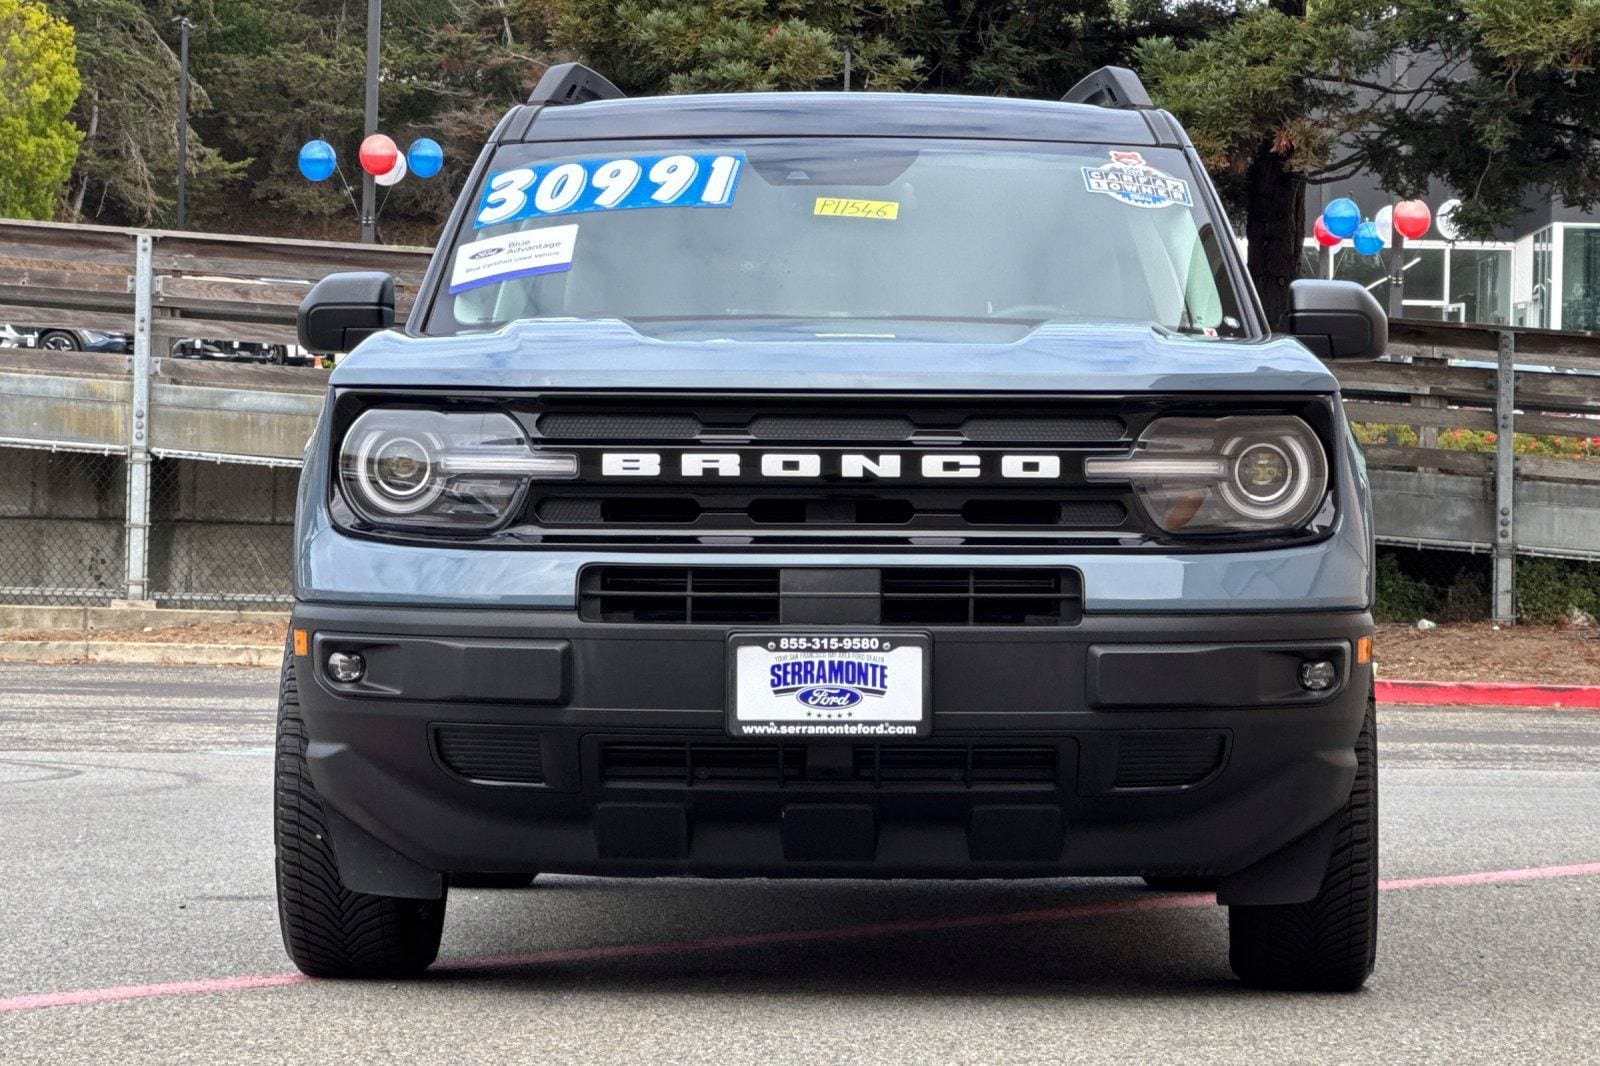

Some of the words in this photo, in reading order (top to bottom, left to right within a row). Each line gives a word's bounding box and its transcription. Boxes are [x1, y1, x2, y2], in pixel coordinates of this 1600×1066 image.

[477, 154, 741, 224] 30991
[1090, 171, 1184, 191] CARFAX
[1109, 182, 1184, 201] OWNER
[506, 241, 562, 255] Advantage
[508, 240, 531, 249] Blue
[602, 453, 1060, 478] BRONCO
[780, 638, 879, 650] 855-315-9580
[770, 660, 888, 689] SERRAMONTE
[808, 688, 850, 706] Ford
[742, 723, 917, 735] www.serramonteford.com
